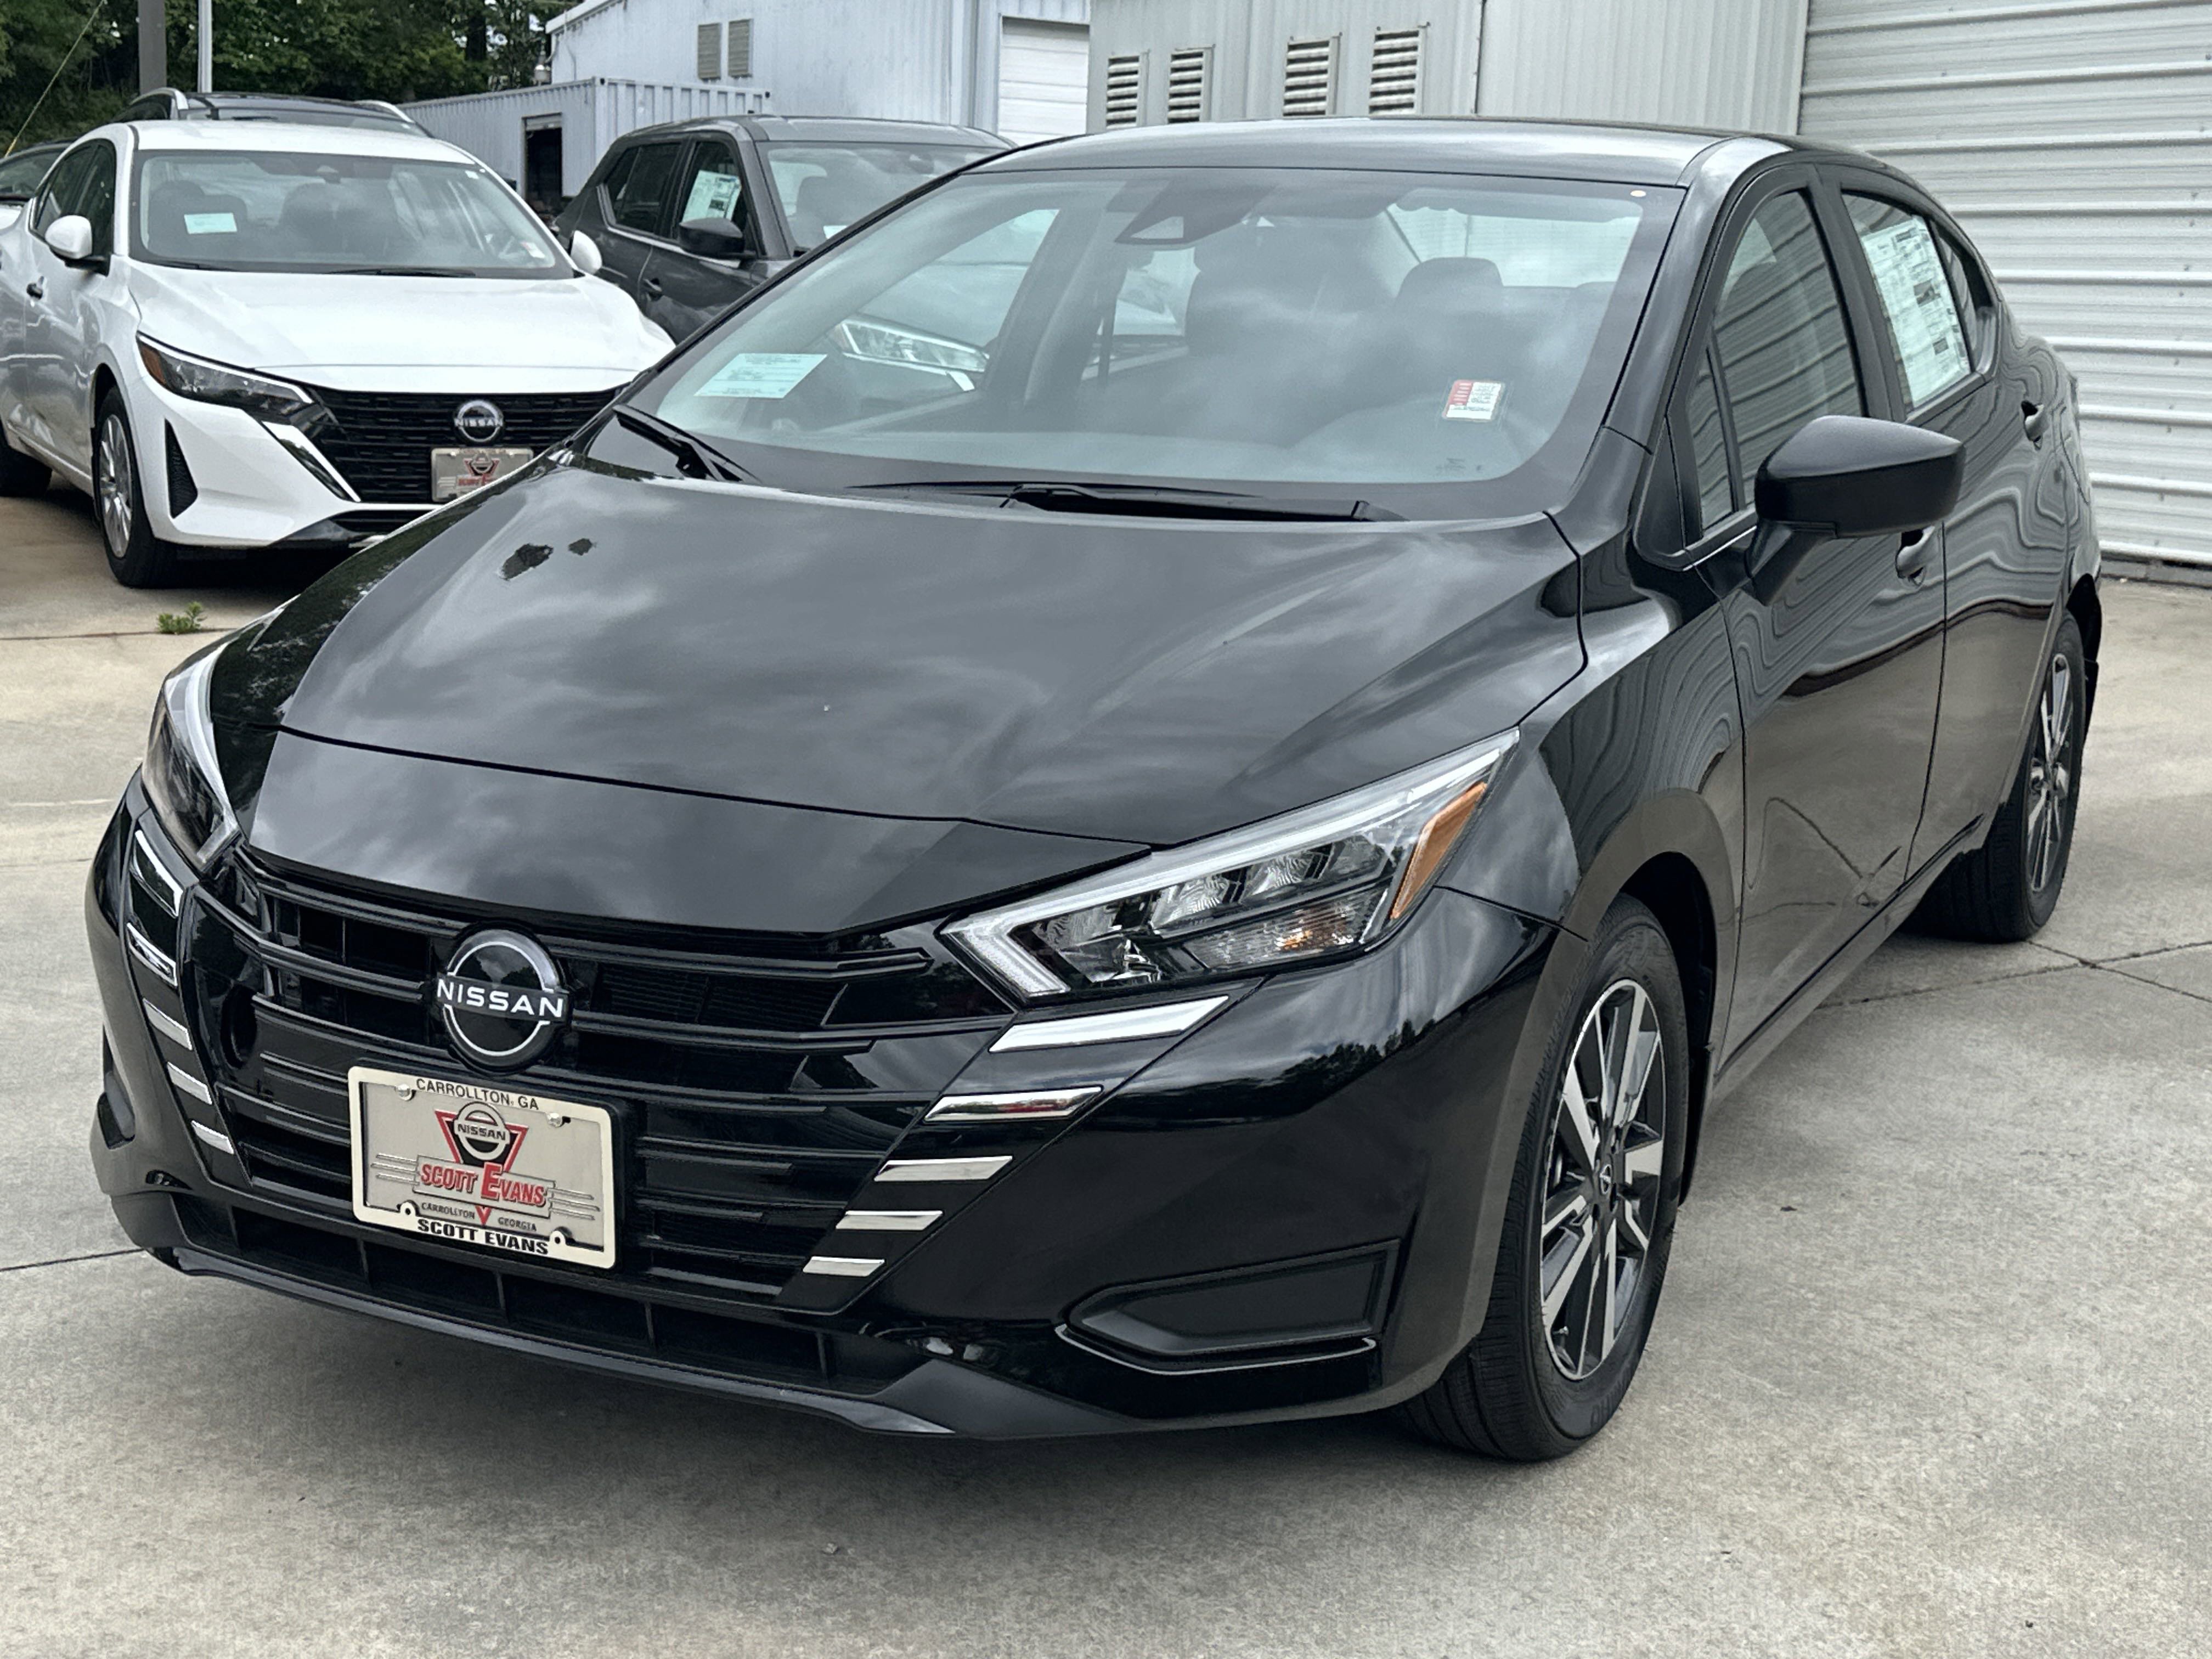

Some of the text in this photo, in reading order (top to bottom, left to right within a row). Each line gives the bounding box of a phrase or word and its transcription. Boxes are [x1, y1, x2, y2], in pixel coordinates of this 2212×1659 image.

[454, 417, 503, 427] NISSAN
[437, 979, 563, 1017] NISSAN
[518, 1096, 539, 1110] GA
[458, 1124, 506, 1141] NISSAN
[421, 1161, 548, 1207] SCOTT EVANS
[421, 1202, 537, 1232] CARROLLTON GEORGIA
[417, 1218, 549, 1255] SCOTT EVANS
